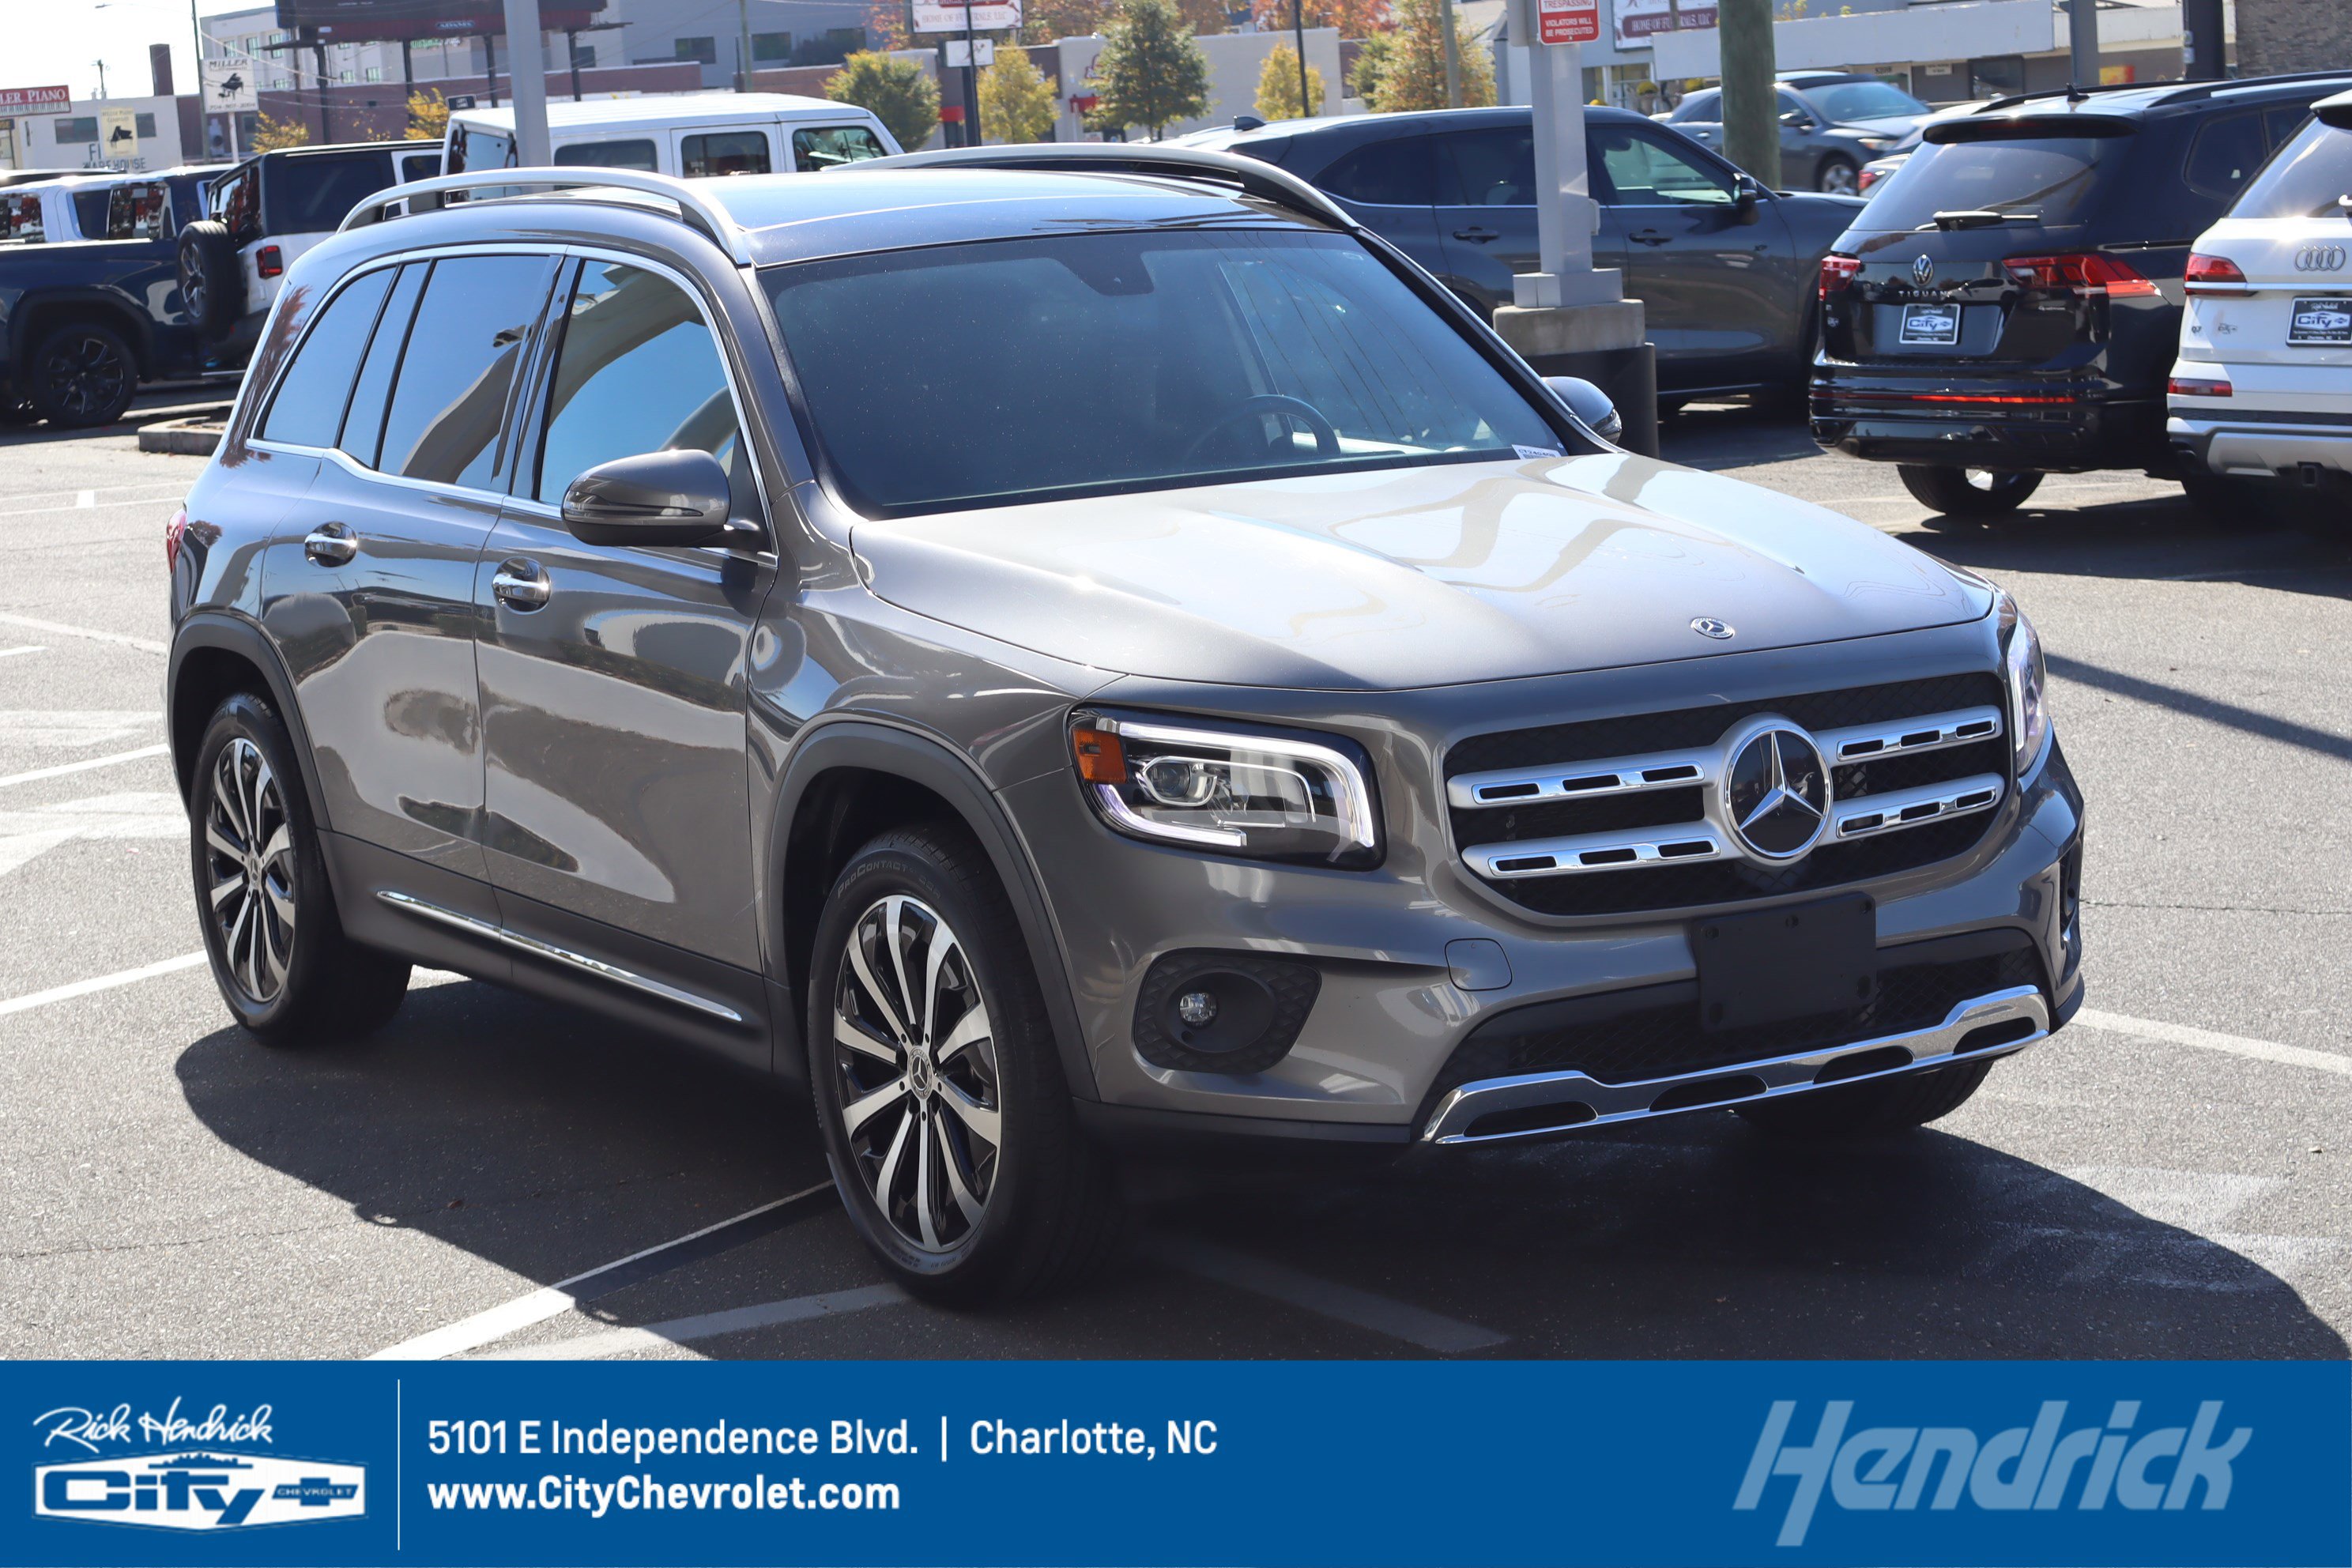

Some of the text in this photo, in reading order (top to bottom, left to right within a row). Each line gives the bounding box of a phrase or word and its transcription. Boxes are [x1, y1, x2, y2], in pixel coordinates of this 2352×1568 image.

[1545, 17, 1592, 27] VIOLATORS WILL
[1555, 26, 1595, 36] PROSECUTED
[209, 58, 247, 67] MILLER
[28, 89, 66, 103] PIANO
